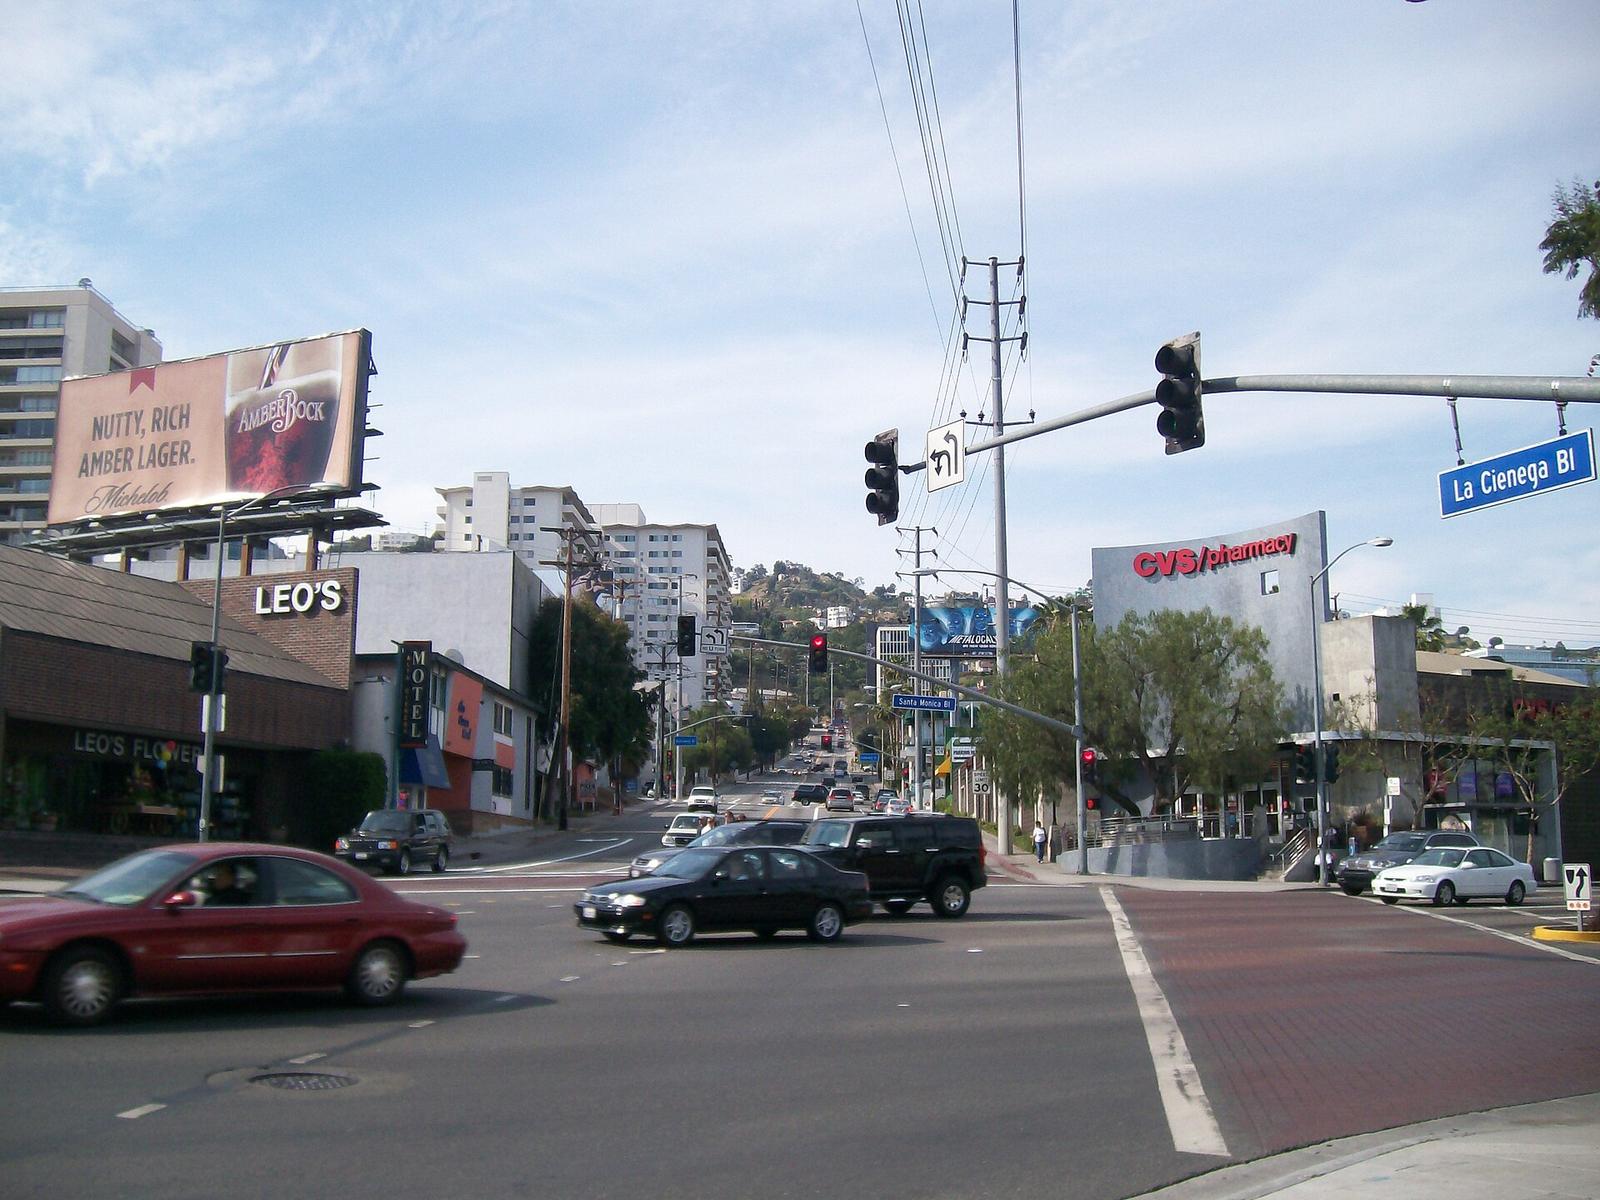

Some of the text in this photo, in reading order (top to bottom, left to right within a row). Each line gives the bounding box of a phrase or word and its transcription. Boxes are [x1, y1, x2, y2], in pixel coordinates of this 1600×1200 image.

[92, 403, 190, 442] NUTTY, RICH
[78, 440, 195, 479] AMBER LAGER.
[1453, 447, 1575, 502] La Cienega Bl
[255, 579, 341, 615] LEO'S
[411, 650, 426, 738] MOTEL
[898, 697, 918, 706] Santa
[920, 699, 943, 708] Monica
[74, 730, 125, 757] LEO'S
[974, 783, 989, 792] 30
